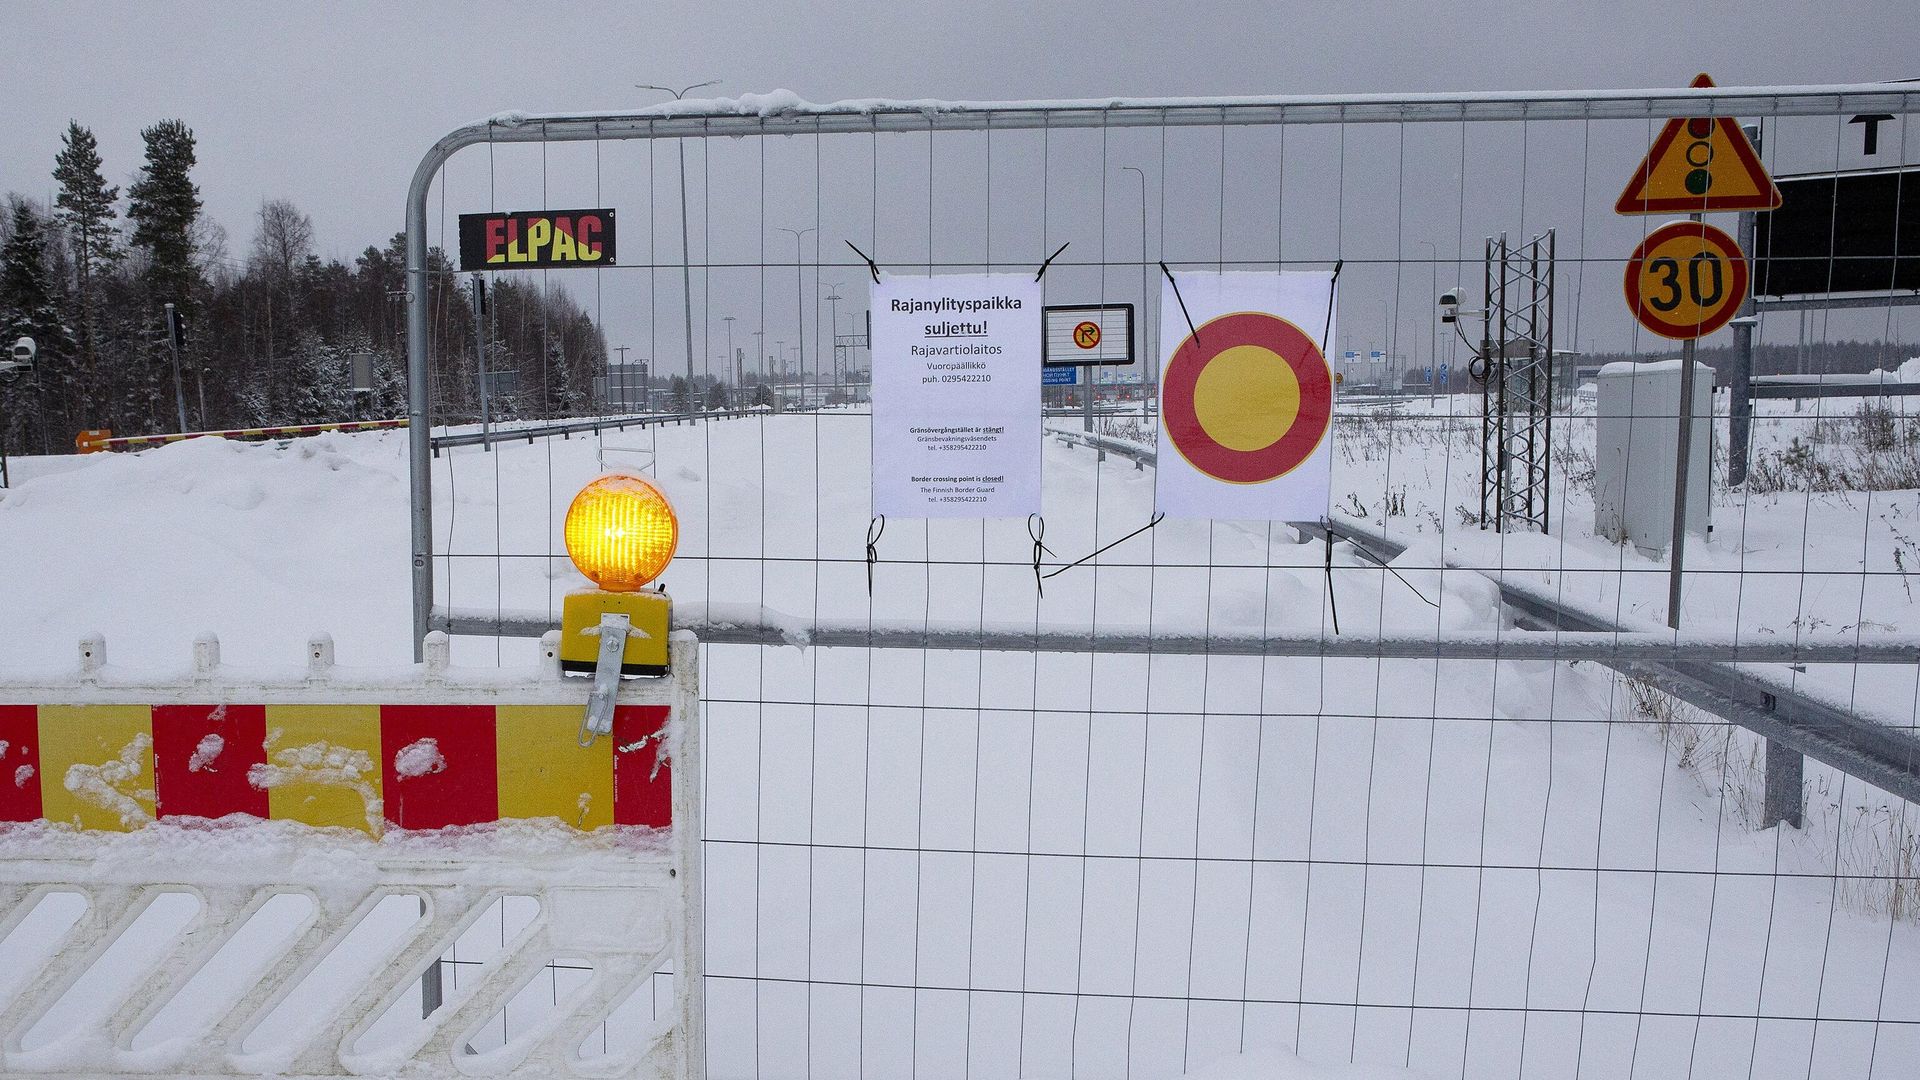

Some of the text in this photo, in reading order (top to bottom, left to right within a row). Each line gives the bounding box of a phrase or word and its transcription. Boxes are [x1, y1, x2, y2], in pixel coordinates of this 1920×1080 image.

[486, 215, 602, 263] ELPAC
[1649, 251, 1723, 311] 30
[891, 296, 1022, 313] Rajanylityspaikka
[924, 321, 988, 338] suljettu!
[911, 345, 1002, 358] Rajavartiolaitos
[927, 362, 986, 371] Vuoropäällikkö
[922, 374, 991, 384] puh. 0295422210
